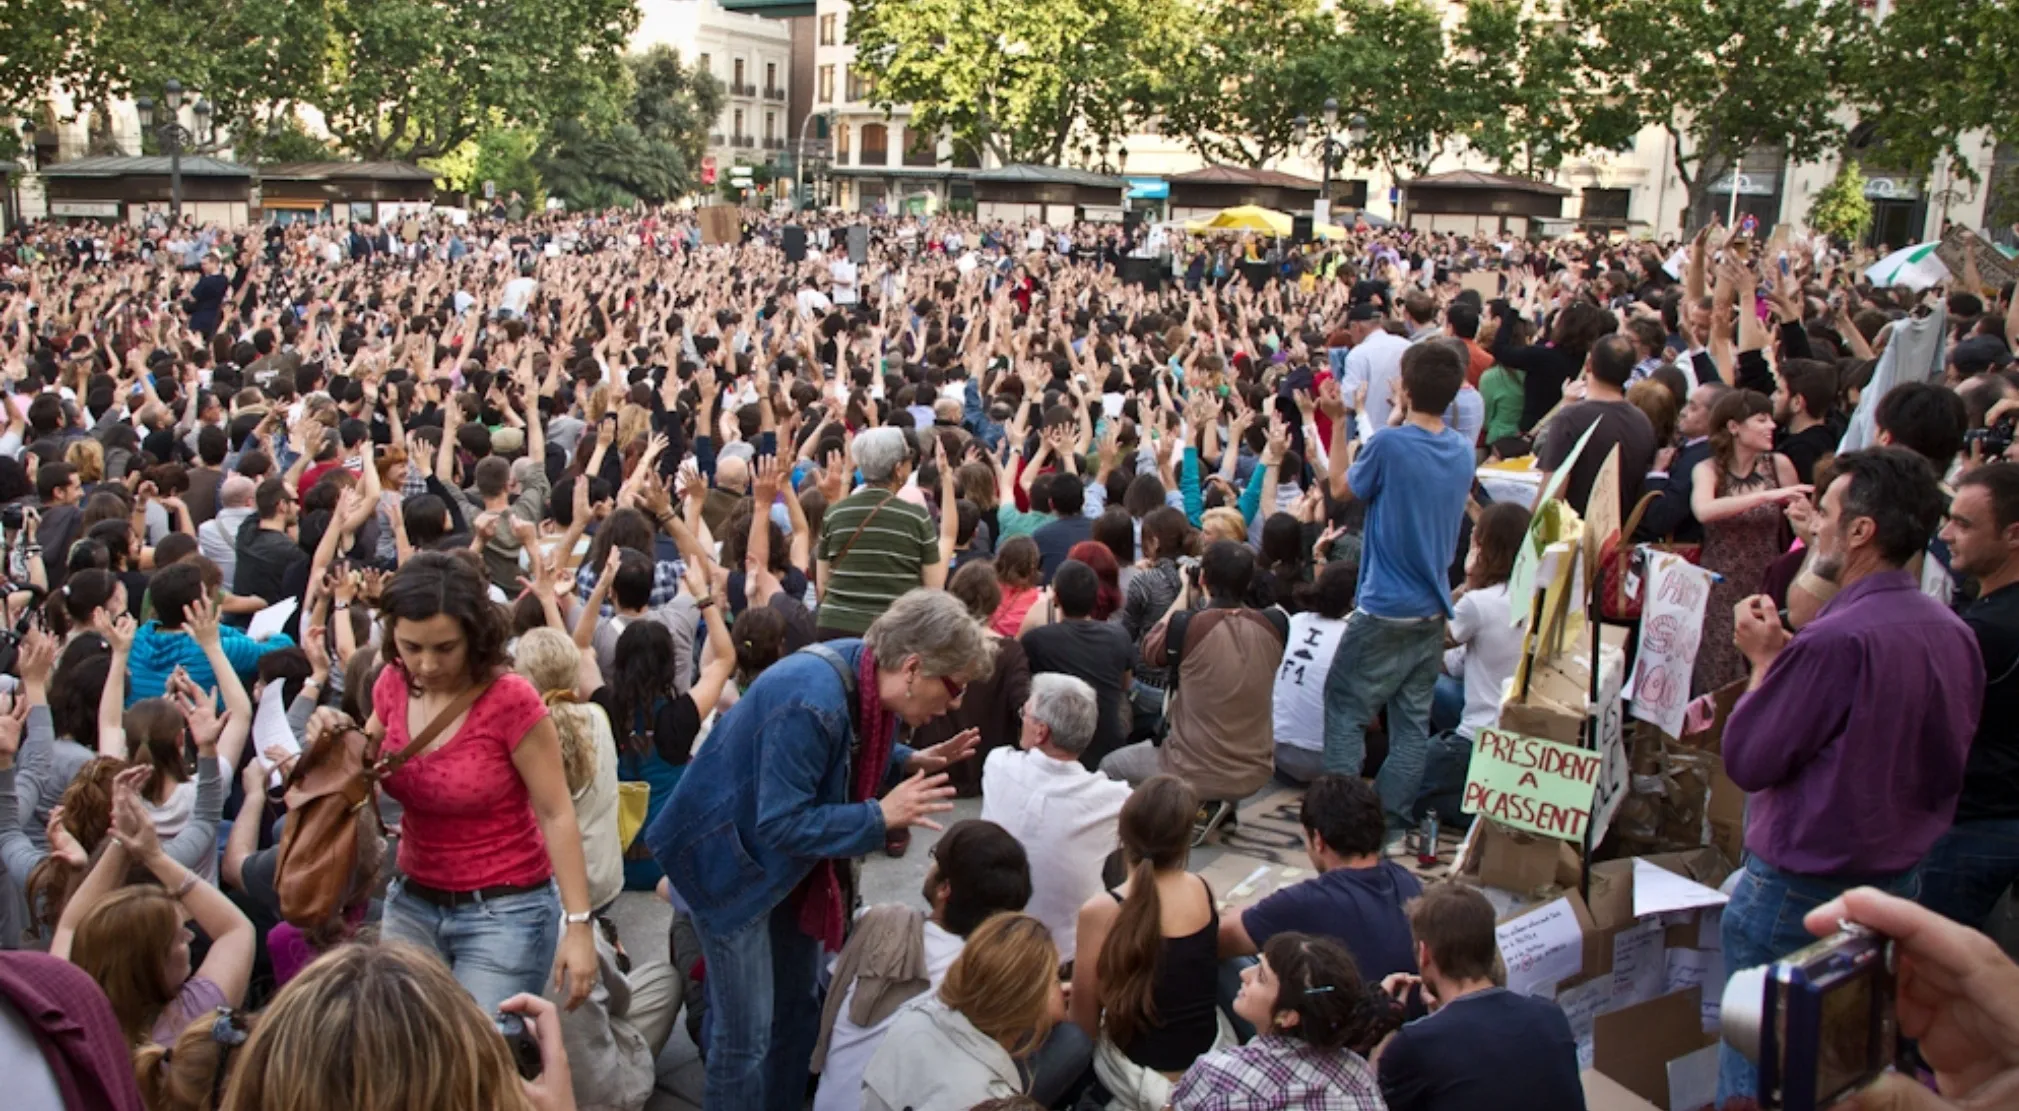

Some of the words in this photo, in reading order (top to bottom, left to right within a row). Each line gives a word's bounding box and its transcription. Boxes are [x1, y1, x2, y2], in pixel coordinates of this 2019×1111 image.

[1304, 626, 1323, 647] I
[1281, 659, 1306, 686] F1
[1480, 731, 1602, 784] PRESIDENT
[1518, 772, 1538, 789] A
[1464, 780, 1590, 835] PICASSENT
